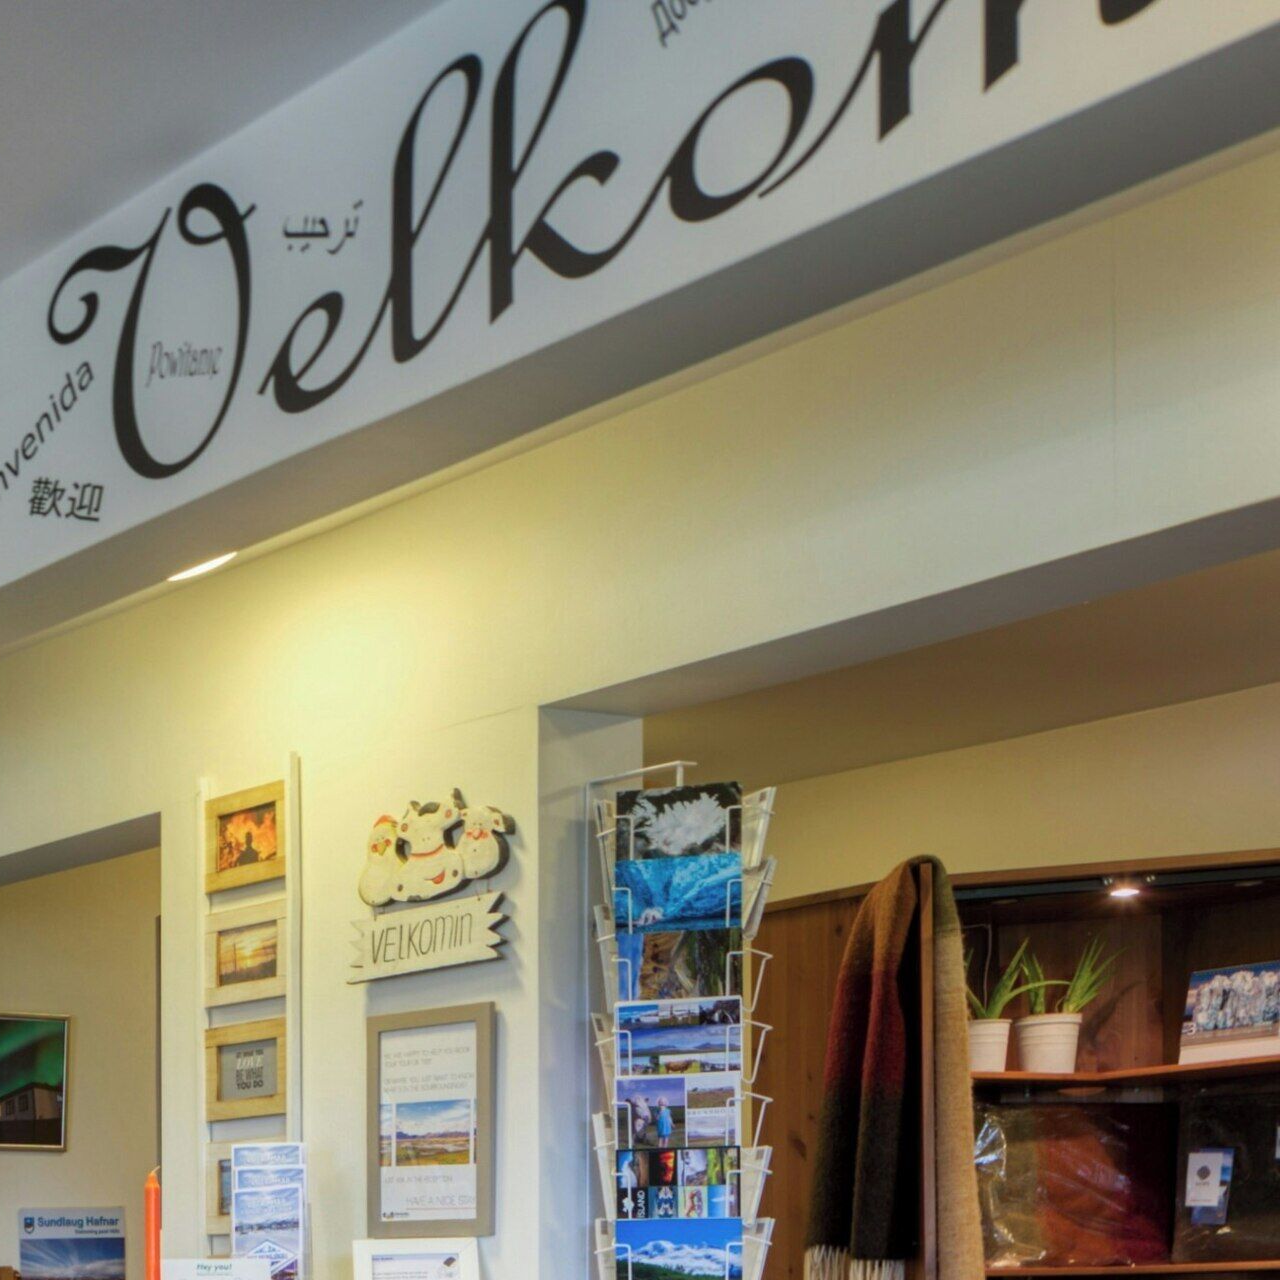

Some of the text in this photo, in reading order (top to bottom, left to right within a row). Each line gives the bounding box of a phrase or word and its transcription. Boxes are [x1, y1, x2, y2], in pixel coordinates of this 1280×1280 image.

[28, 477, 104, 522] 歡迎
[237, 1080, 264, 1090] YOU DO
[37, 1216, 120, 1229] Sundlaug Hafnar
[197, 1263, 232, 1271] Hey you!
